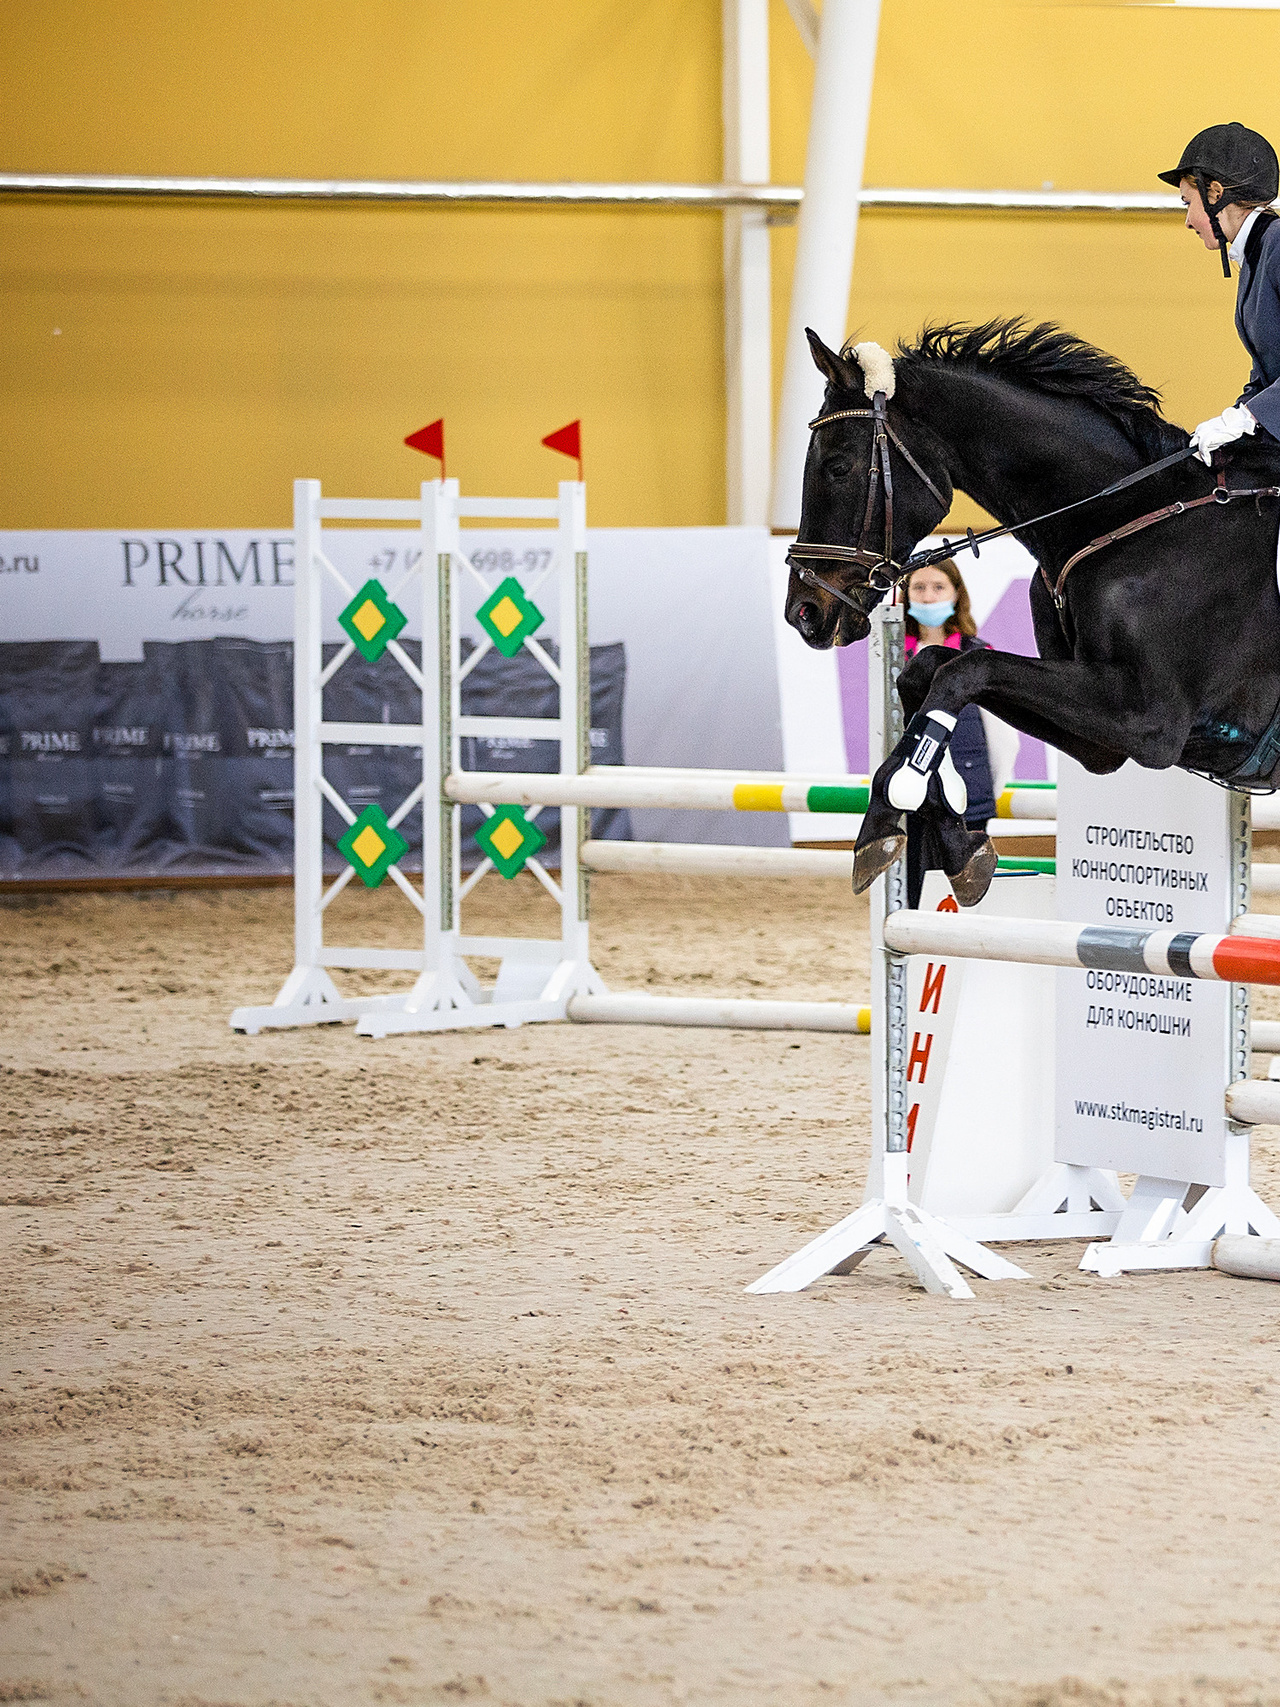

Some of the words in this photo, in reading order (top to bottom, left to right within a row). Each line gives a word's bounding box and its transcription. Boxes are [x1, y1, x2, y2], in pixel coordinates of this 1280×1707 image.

[120, 538, 295, 587] PRIME
[469, 547, 552, 573] 698-97
[20, 729, 82, 751] PRIME
[247, 727, 295, 748] PRIM
[1085, 825, 1195, 855] СТРОИТЕЛЬСТВО
[1071, 858, 1209, 892] КОННОСПОРТИВНЫХ
[1105, 896, 1175, 924] ОБЪЕКТОВ
[1086, 969, 1193, 1003] ОБОРУДОВАНИЕ
[1086, 1005, 1114, 1030] ДЛЯ
[1116, 1008, 1192, 1038] КОНЮШНИ
[1074, 1098, 1204, 1133] www.stkmagistral.ru
